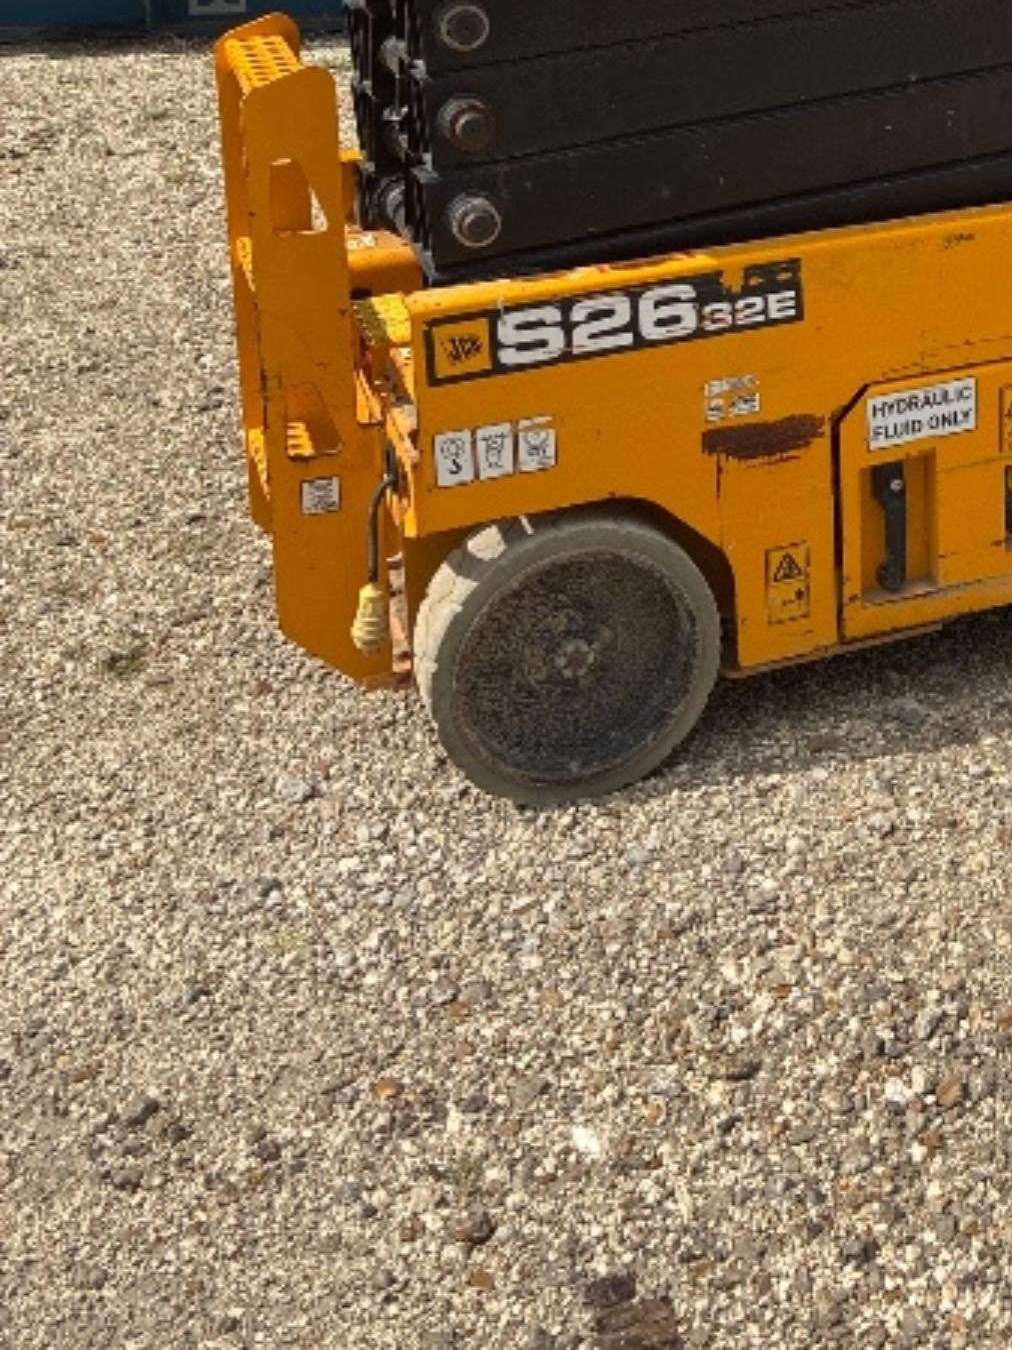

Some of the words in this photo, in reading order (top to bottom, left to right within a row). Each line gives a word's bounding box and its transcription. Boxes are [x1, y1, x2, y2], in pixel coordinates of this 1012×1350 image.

[497, 283, 699, 366] S26
[701, 290, 797, 333] 32E
[872, 384, 973, 419] HYDRAULIC
[872, 418, 923, 442] FLUID
[928, 408, 973, 430] ONLY
